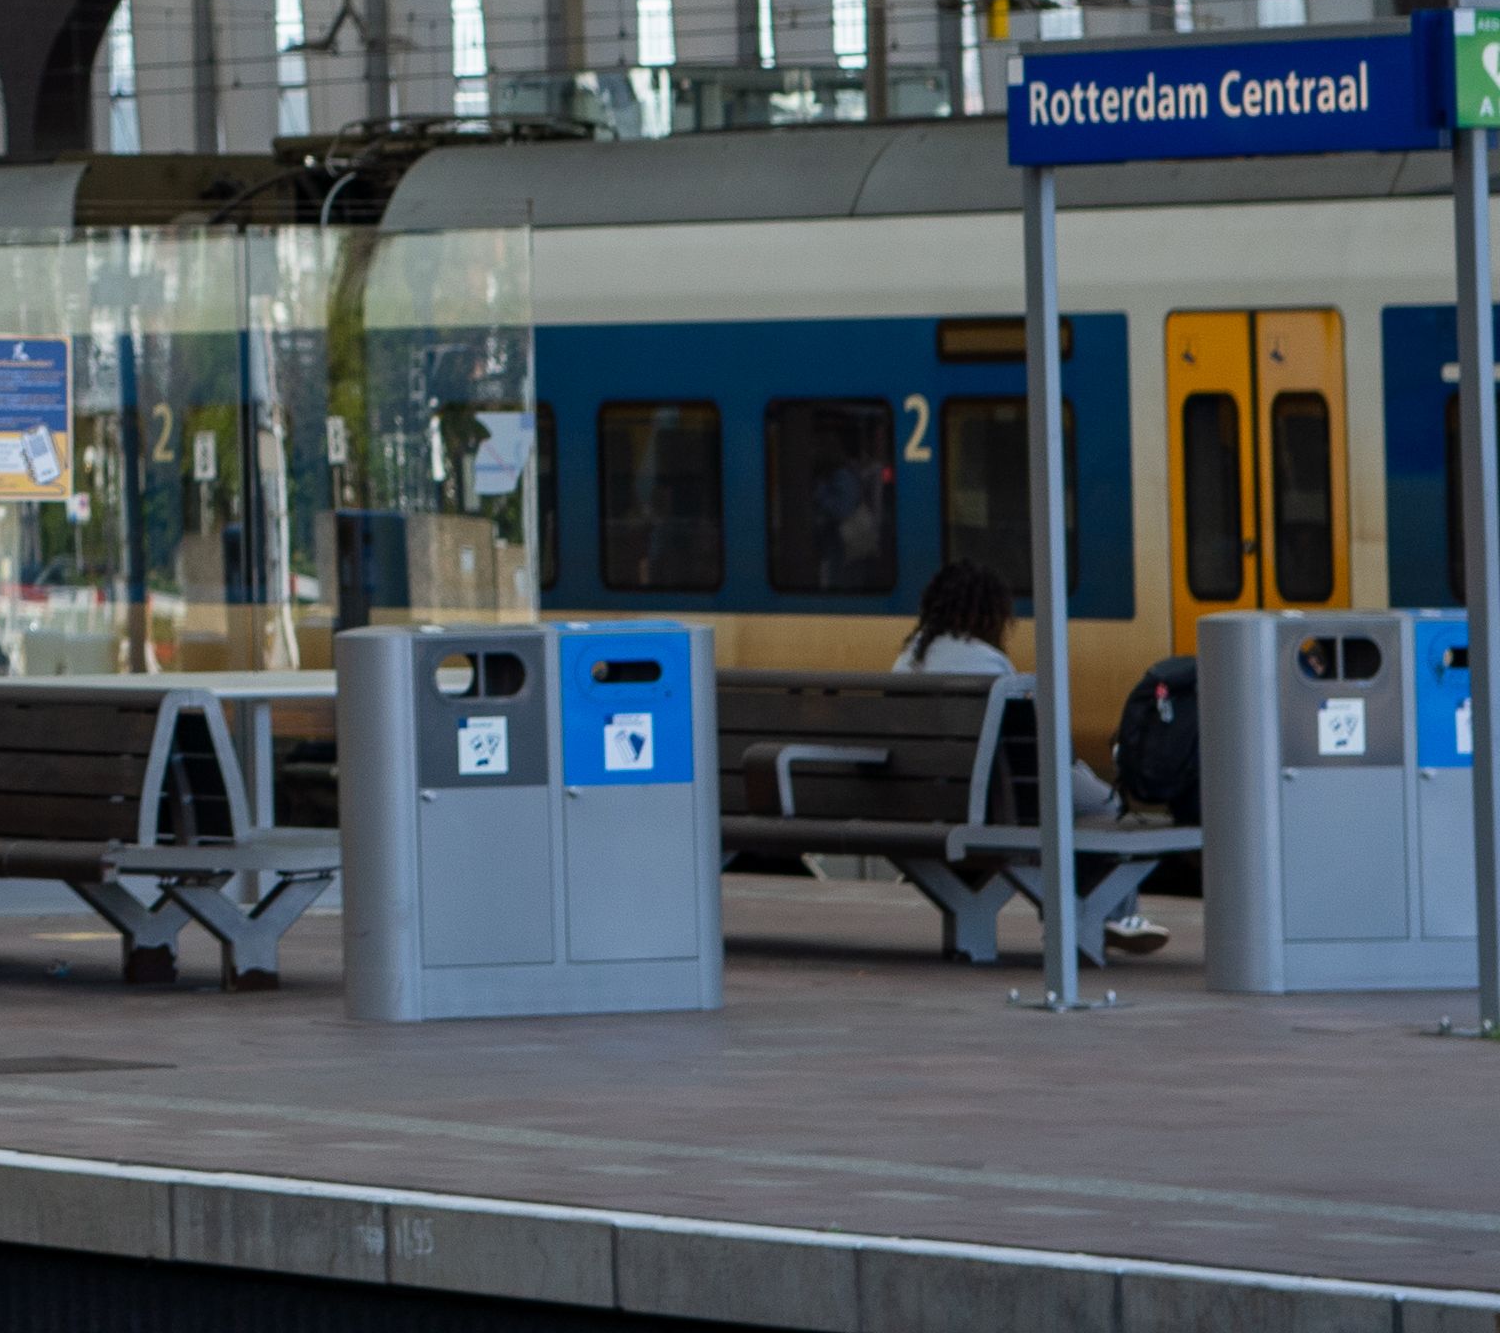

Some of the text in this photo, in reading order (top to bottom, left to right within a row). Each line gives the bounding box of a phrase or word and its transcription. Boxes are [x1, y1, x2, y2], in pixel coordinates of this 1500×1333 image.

[1028, 59, 1369, 127] Rotterdam Centraal
[152, 402, 176, 464] 2
[903, 392, 932, 463] 2
